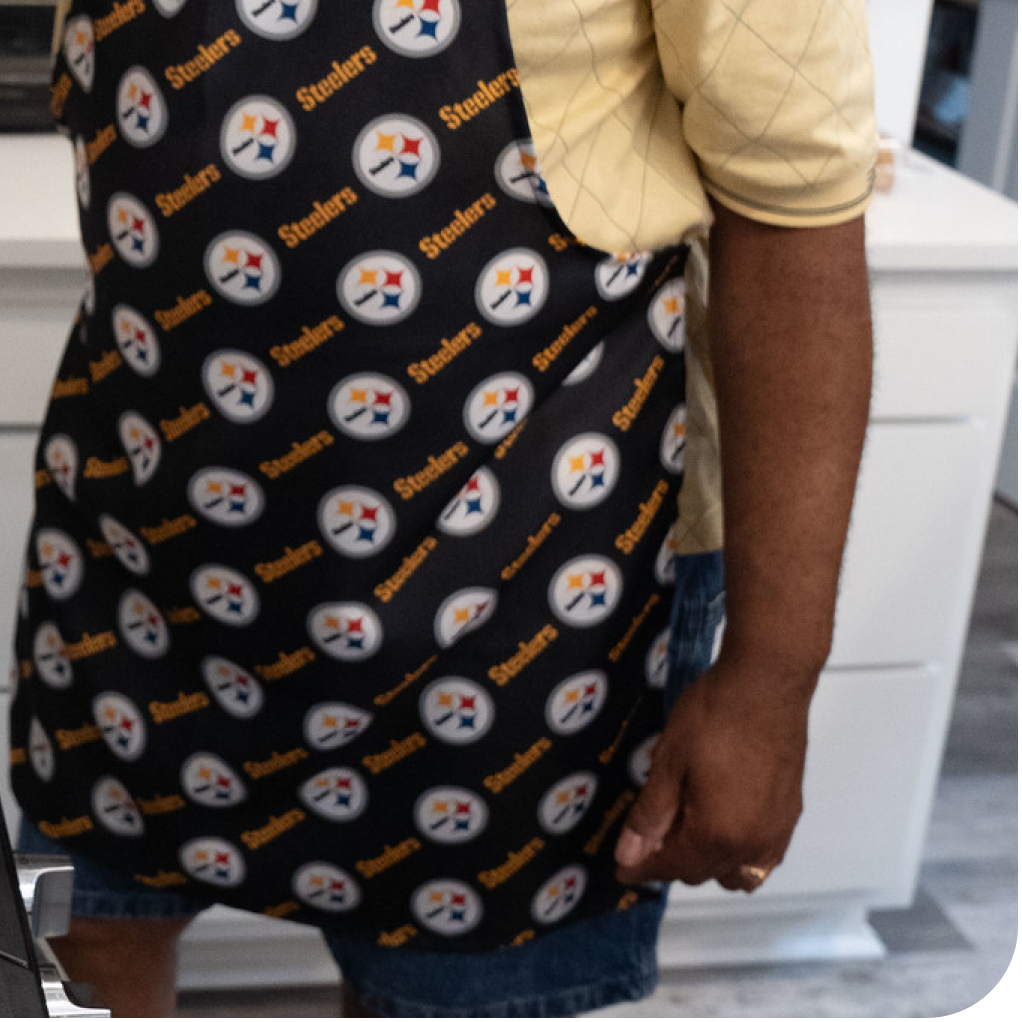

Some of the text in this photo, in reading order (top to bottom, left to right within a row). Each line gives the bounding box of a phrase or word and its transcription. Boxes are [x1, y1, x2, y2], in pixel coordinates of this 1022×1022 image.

[163, 29, 242, 90] Steelers
[295, 44, 378, 112] Steelers
[154, 163, 222, 217] Steelers
[277, 186, 359, 249] Steelers
[418, 192, 497, 260] Steelers
[406, 322, 483, 385] Steelers
[611, 355, 664, 432] Steelers
[392, 441, 469, 500] Steelers
[487, 624, 559, 687] Steelers
